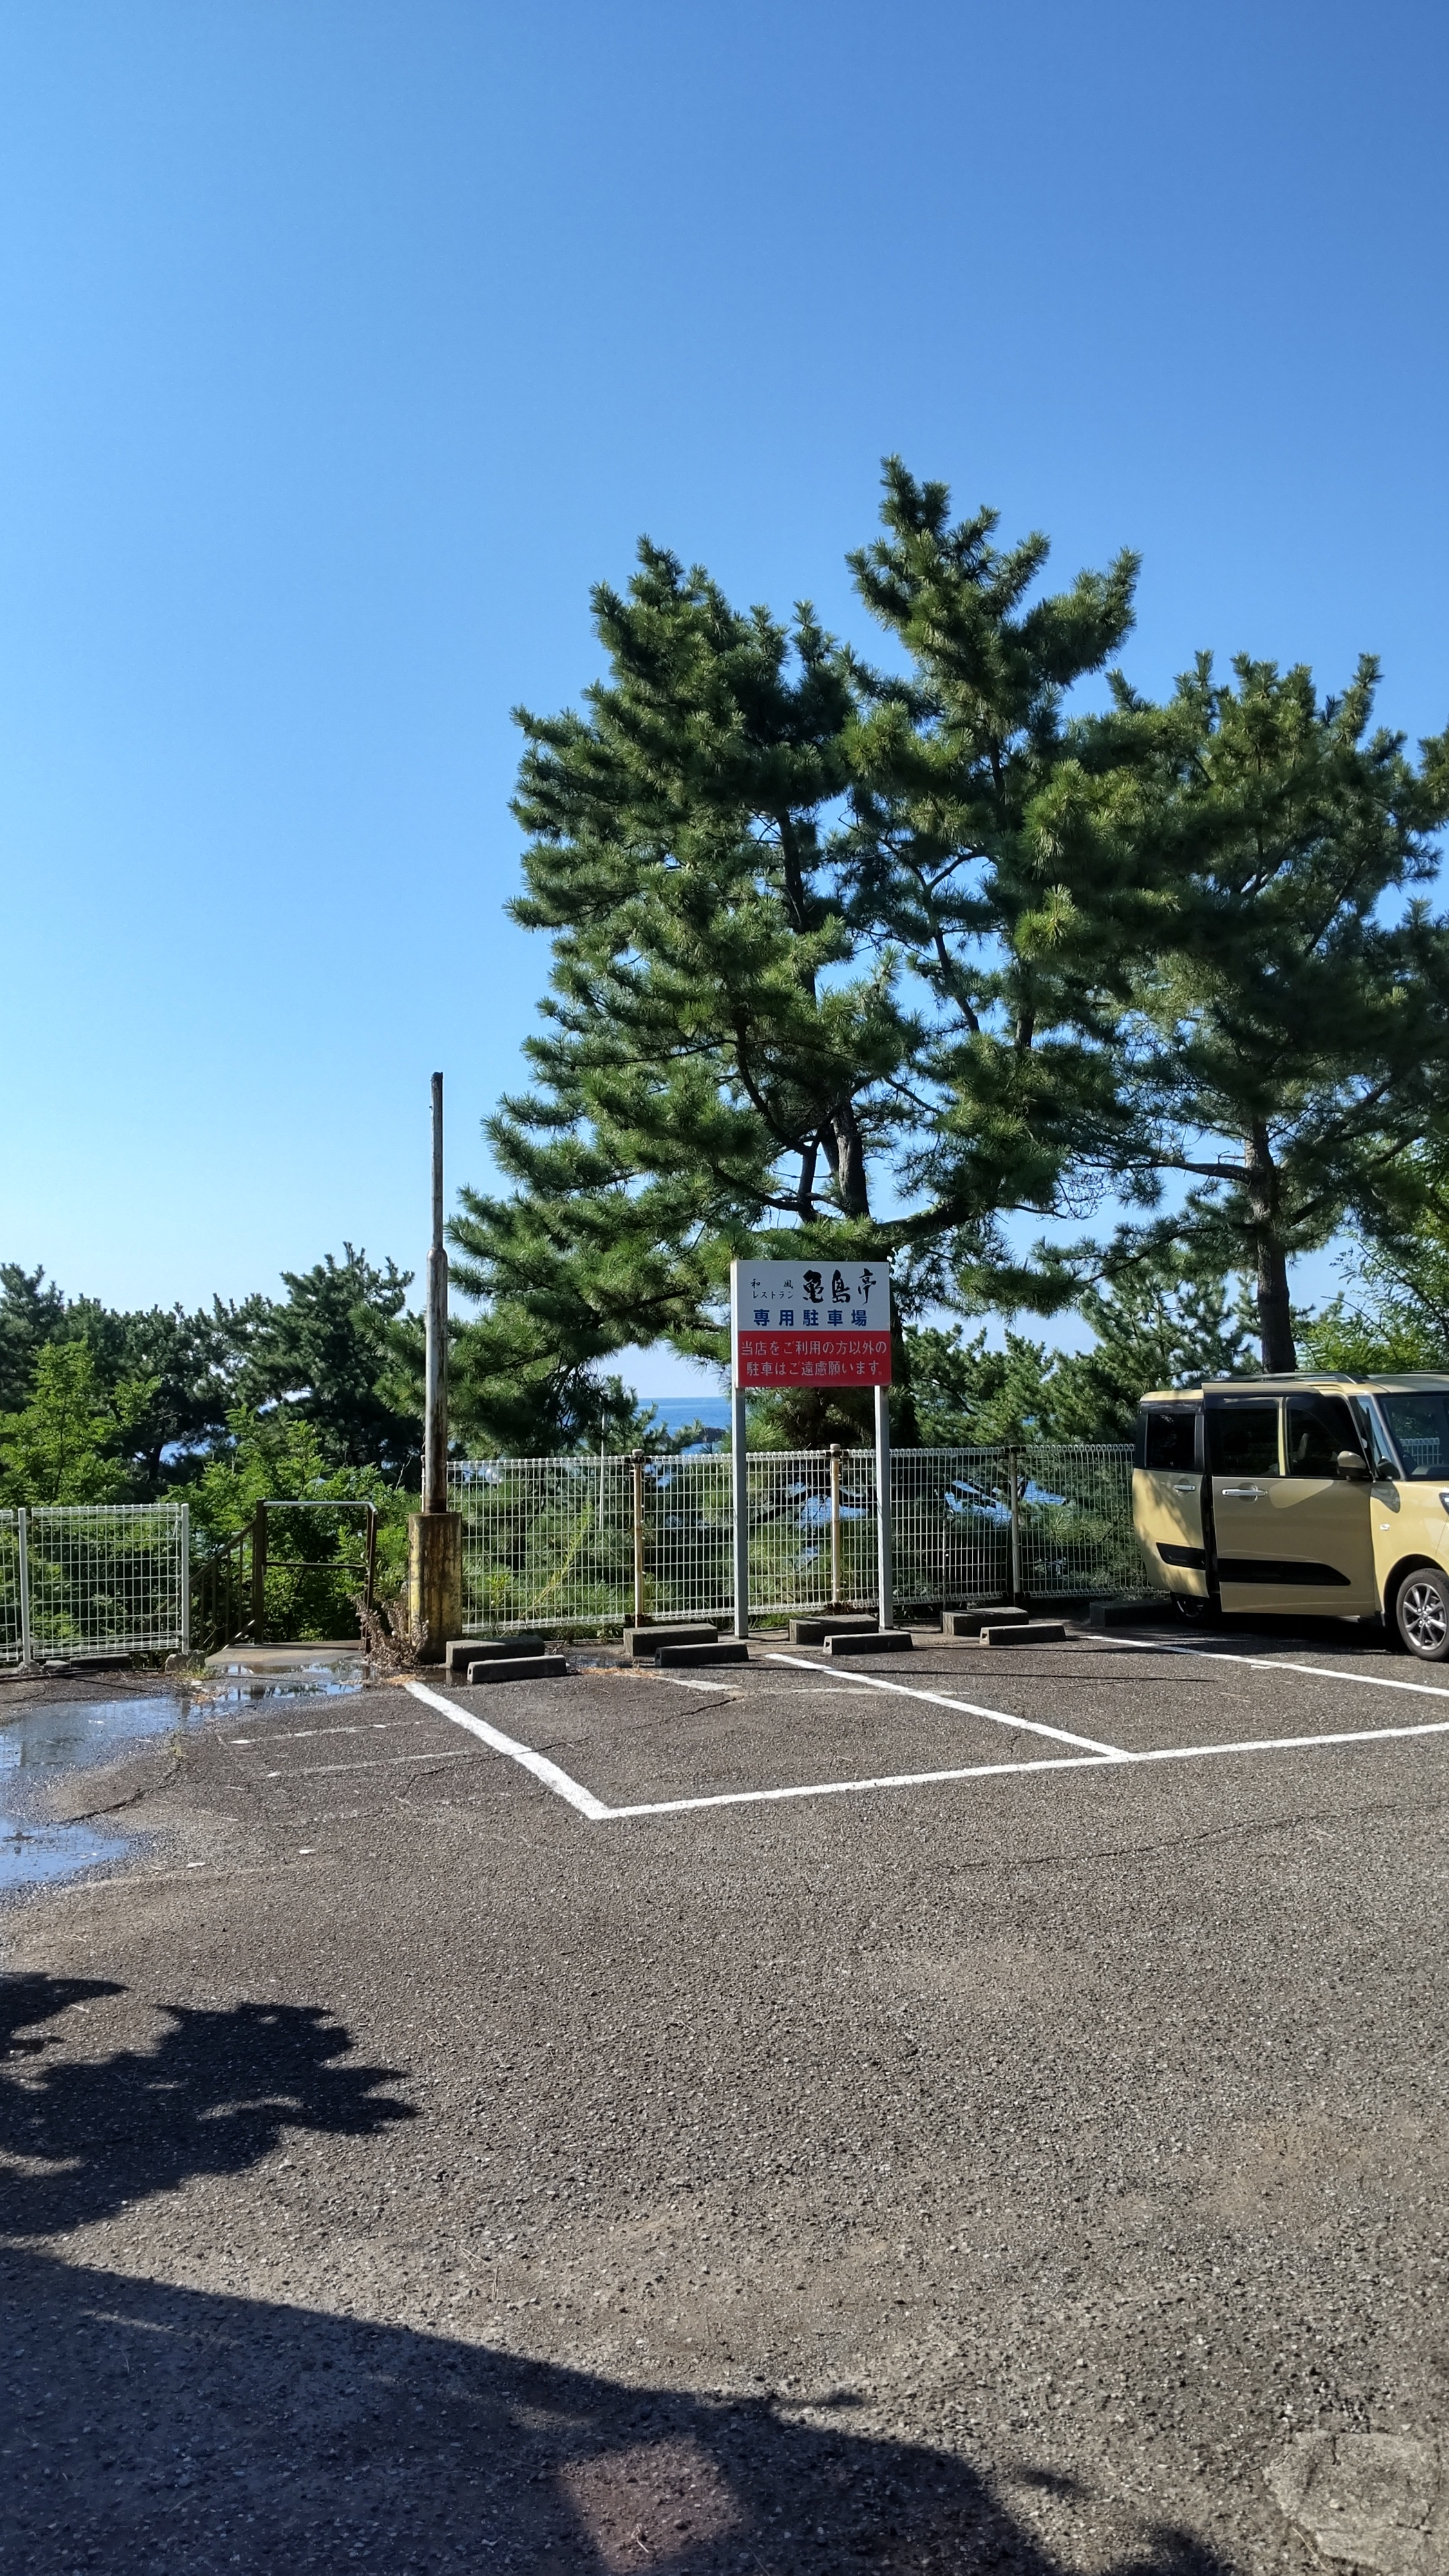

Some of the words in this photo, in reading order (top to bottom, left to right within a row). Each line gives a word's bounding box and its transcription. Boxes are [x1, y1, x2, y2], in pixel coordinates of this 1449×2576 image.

[753, 1291, 793, 1299] レストラン
[753, 1309, 867, 1327] 専用駐車場
[741, 1340, 887, 1356] 当店をご利用の方以外の
[746, 1361, 882, 1376] 駐車はご遠慮願います。
